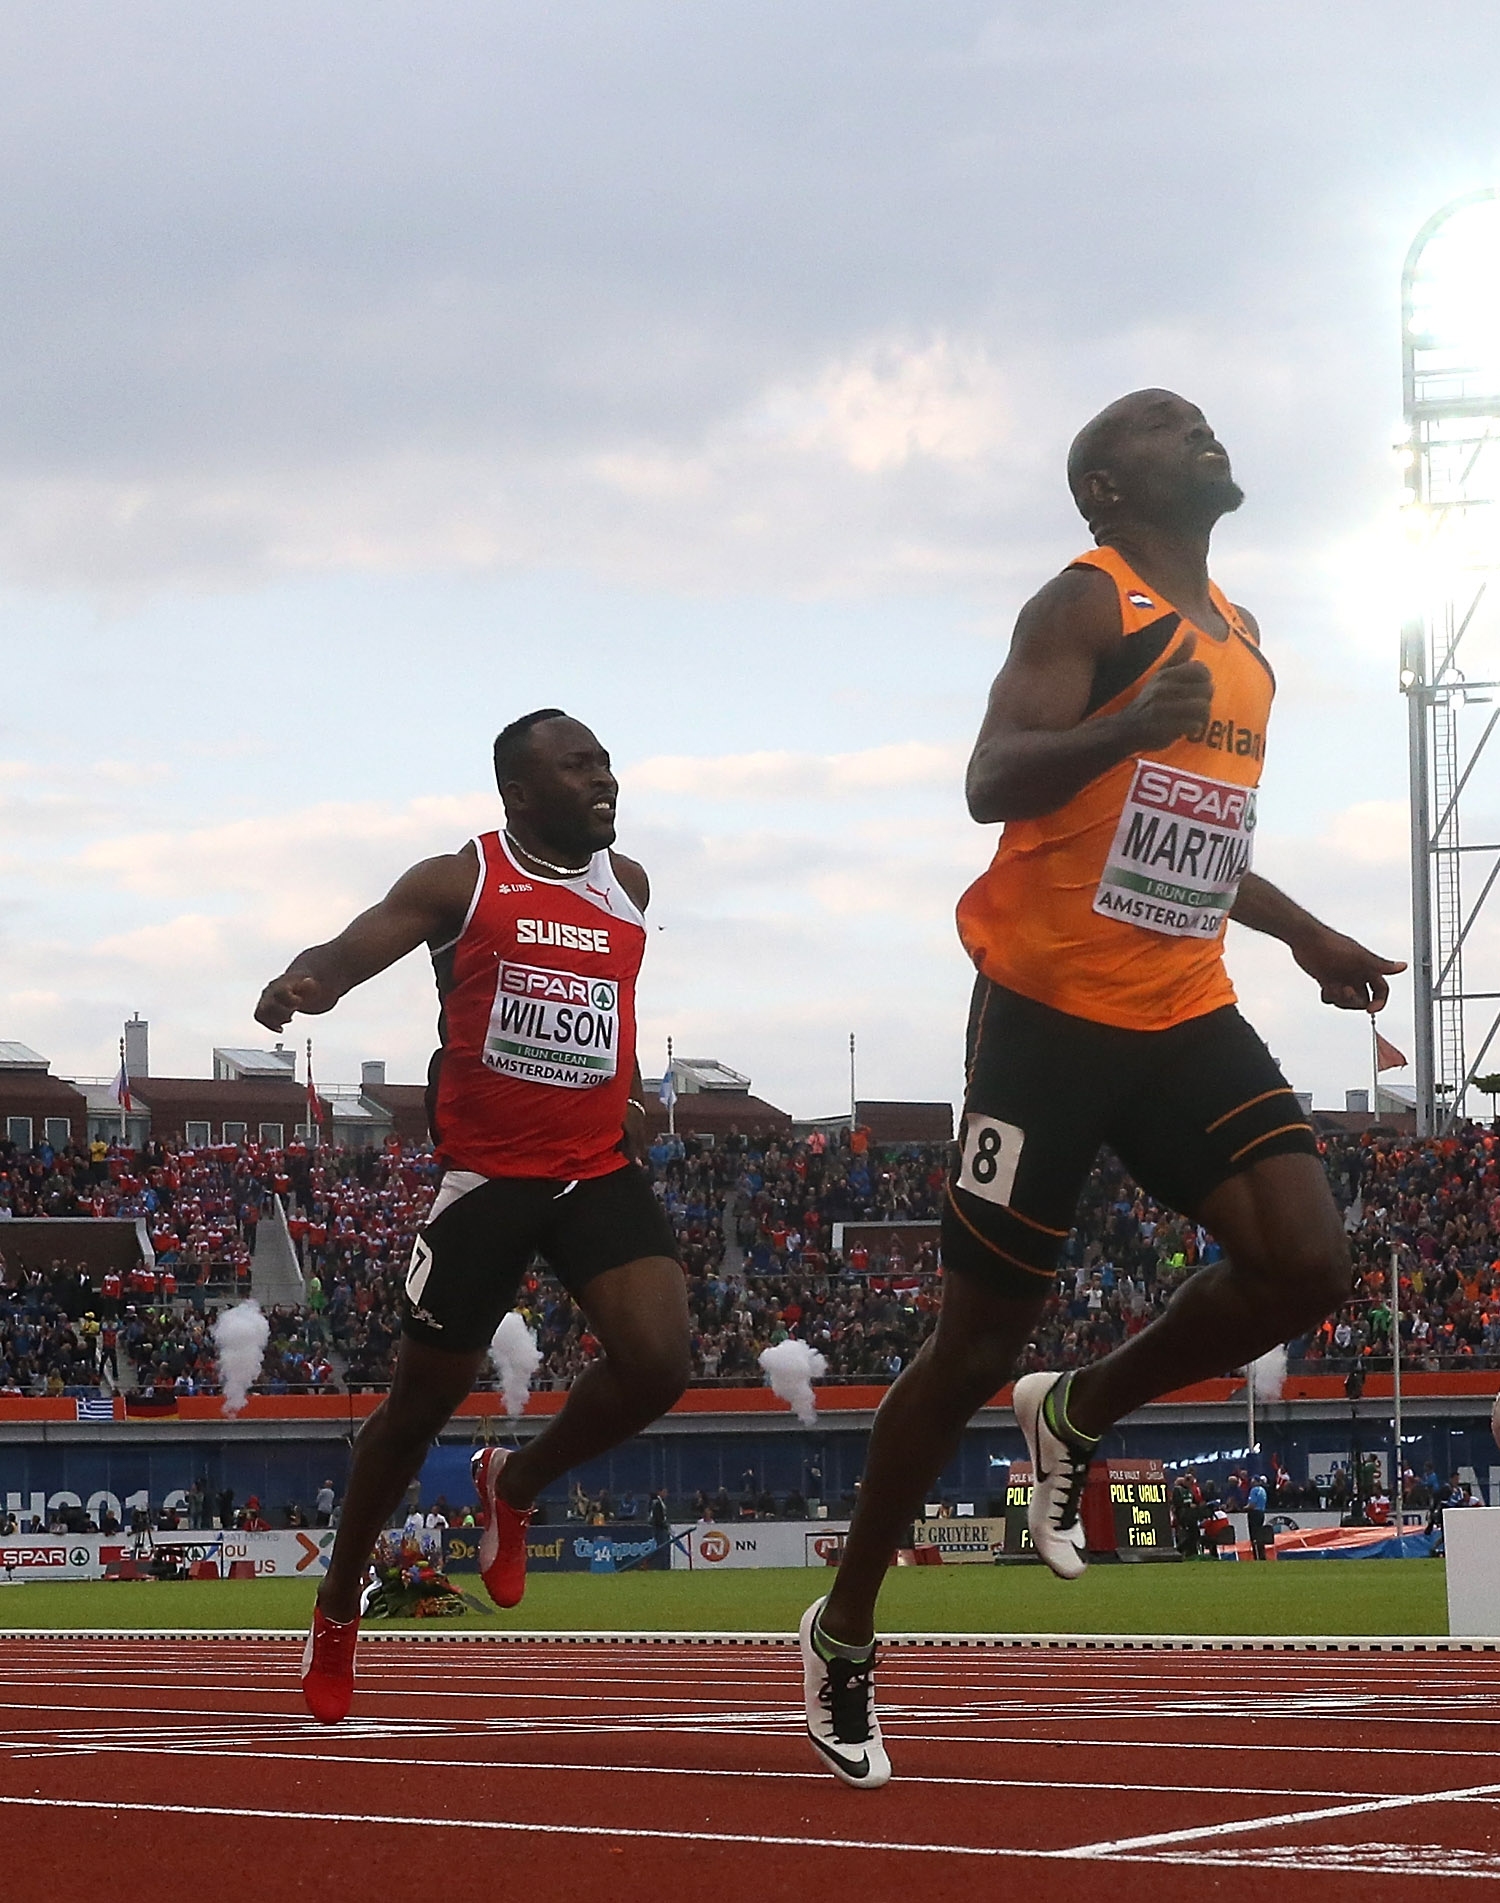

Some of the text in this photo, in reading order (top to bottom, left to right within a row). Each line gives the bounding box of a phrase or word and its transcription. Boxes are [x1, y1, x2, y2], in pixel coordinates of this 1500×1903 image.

[1138, 771, 1245, 823] SPAR
[511, 884, 533, 892] UBS
[1147, 881, 1152, 891] I
[1155, 882, 1187, 902] RUN
[1098, 892, 1199, 929] AMSTERD
[516, 919, 610, 953] SUISSE
[503, 969, 587, 1003] SPAR
[500, 997, 613, 1050] WILSON
[523, 1046, 550, 1060] RUN
[551, 1051, 588, 1066] CLEAN
[486, 1055, 578, 1084] AMSTERDAM
[972, 1127, 1002, 1184] 8
[408, 1246, 428, 1285] 7
[1110, 1484, 1167, 1503] POLE VAULT
[1132, 1505, 1151, 1525] Men
[928, 1523, 989, 1543] GRUYÈRE
[1128, 1527, 1157, 1546] Final
[594, 1546, 612, 1563] 14
[735, 1540, 757, 1552] NN
[3, 1549, 65, 1565] SPAR
